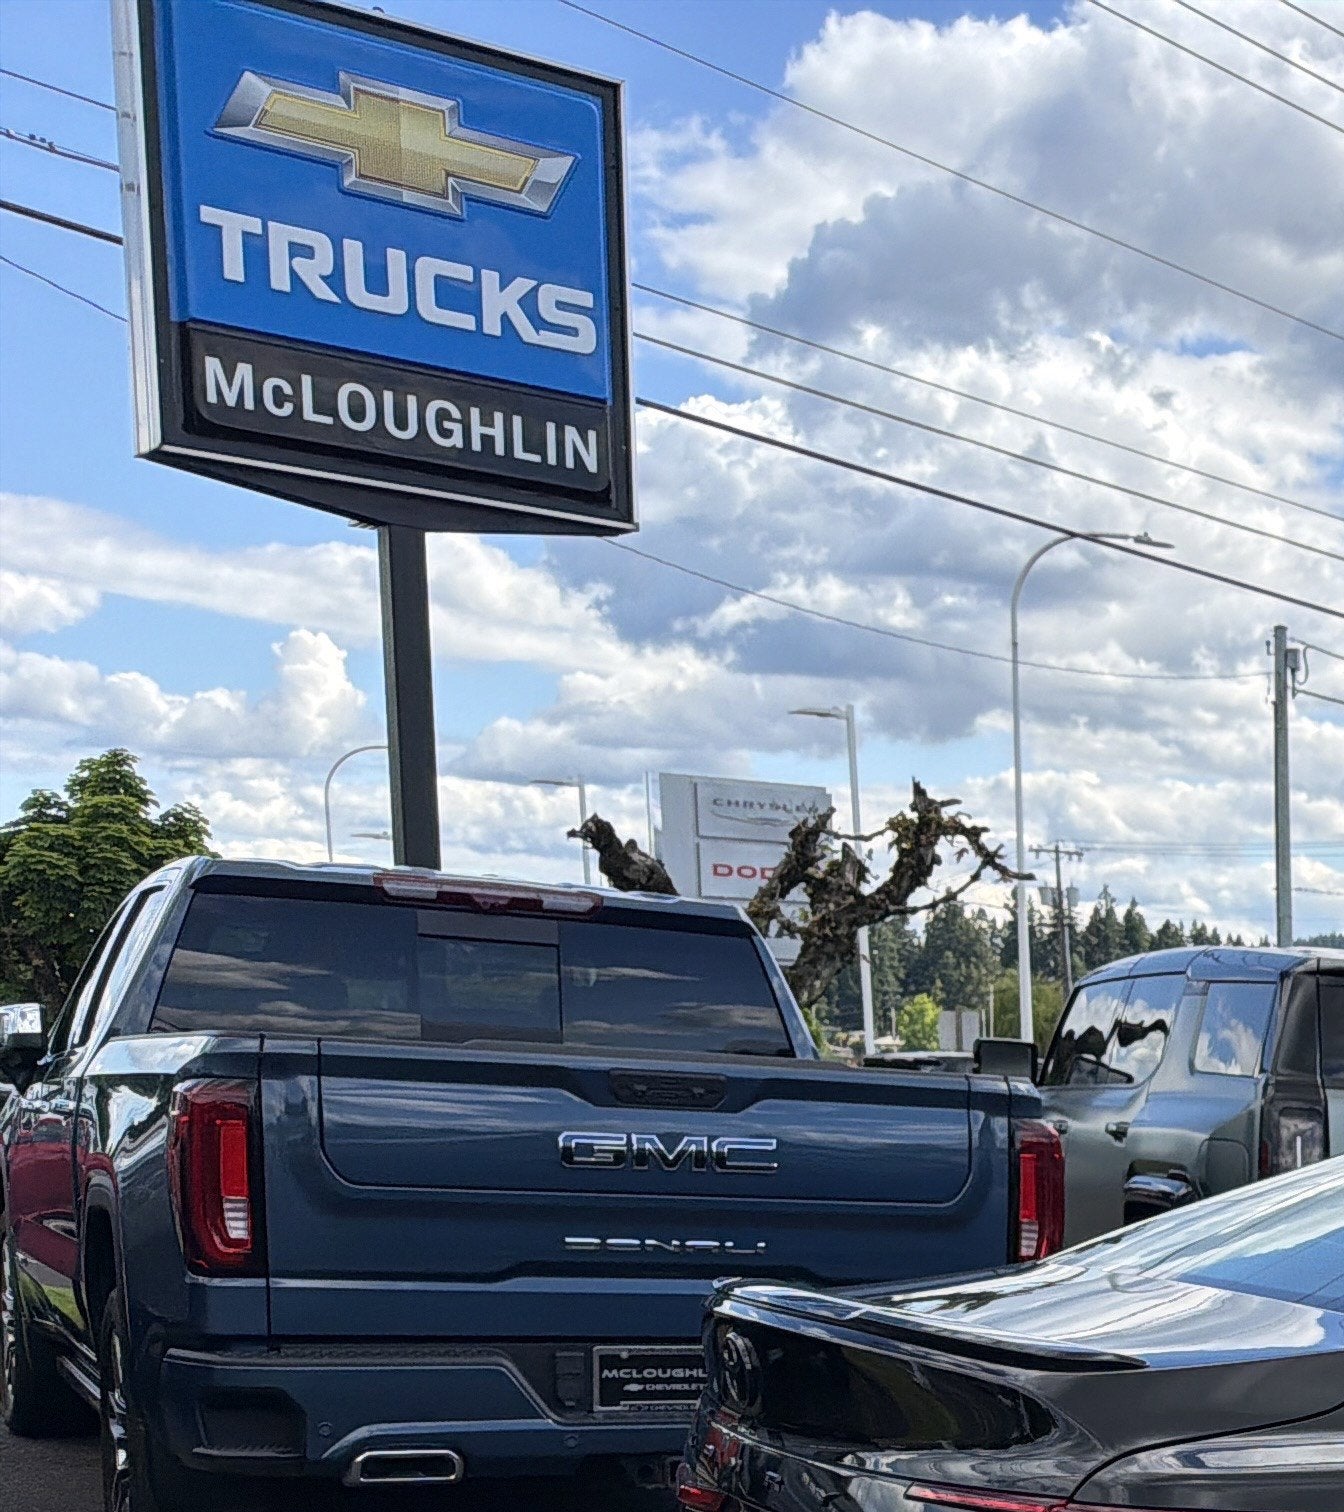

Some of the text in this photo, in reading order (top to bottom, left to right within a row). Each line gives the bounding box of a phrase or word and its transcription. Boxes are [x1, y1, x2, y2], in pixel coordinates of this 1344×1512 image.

[200, 204, 597, 355] TRUCKS
[204, 355, 598, 474] McLOUGHLIN
[712, 863, 778, 880] DOD
[558, 1131, 778, 1174] GMC
[601, 1368, 708, 1379] MCLOUGHL
